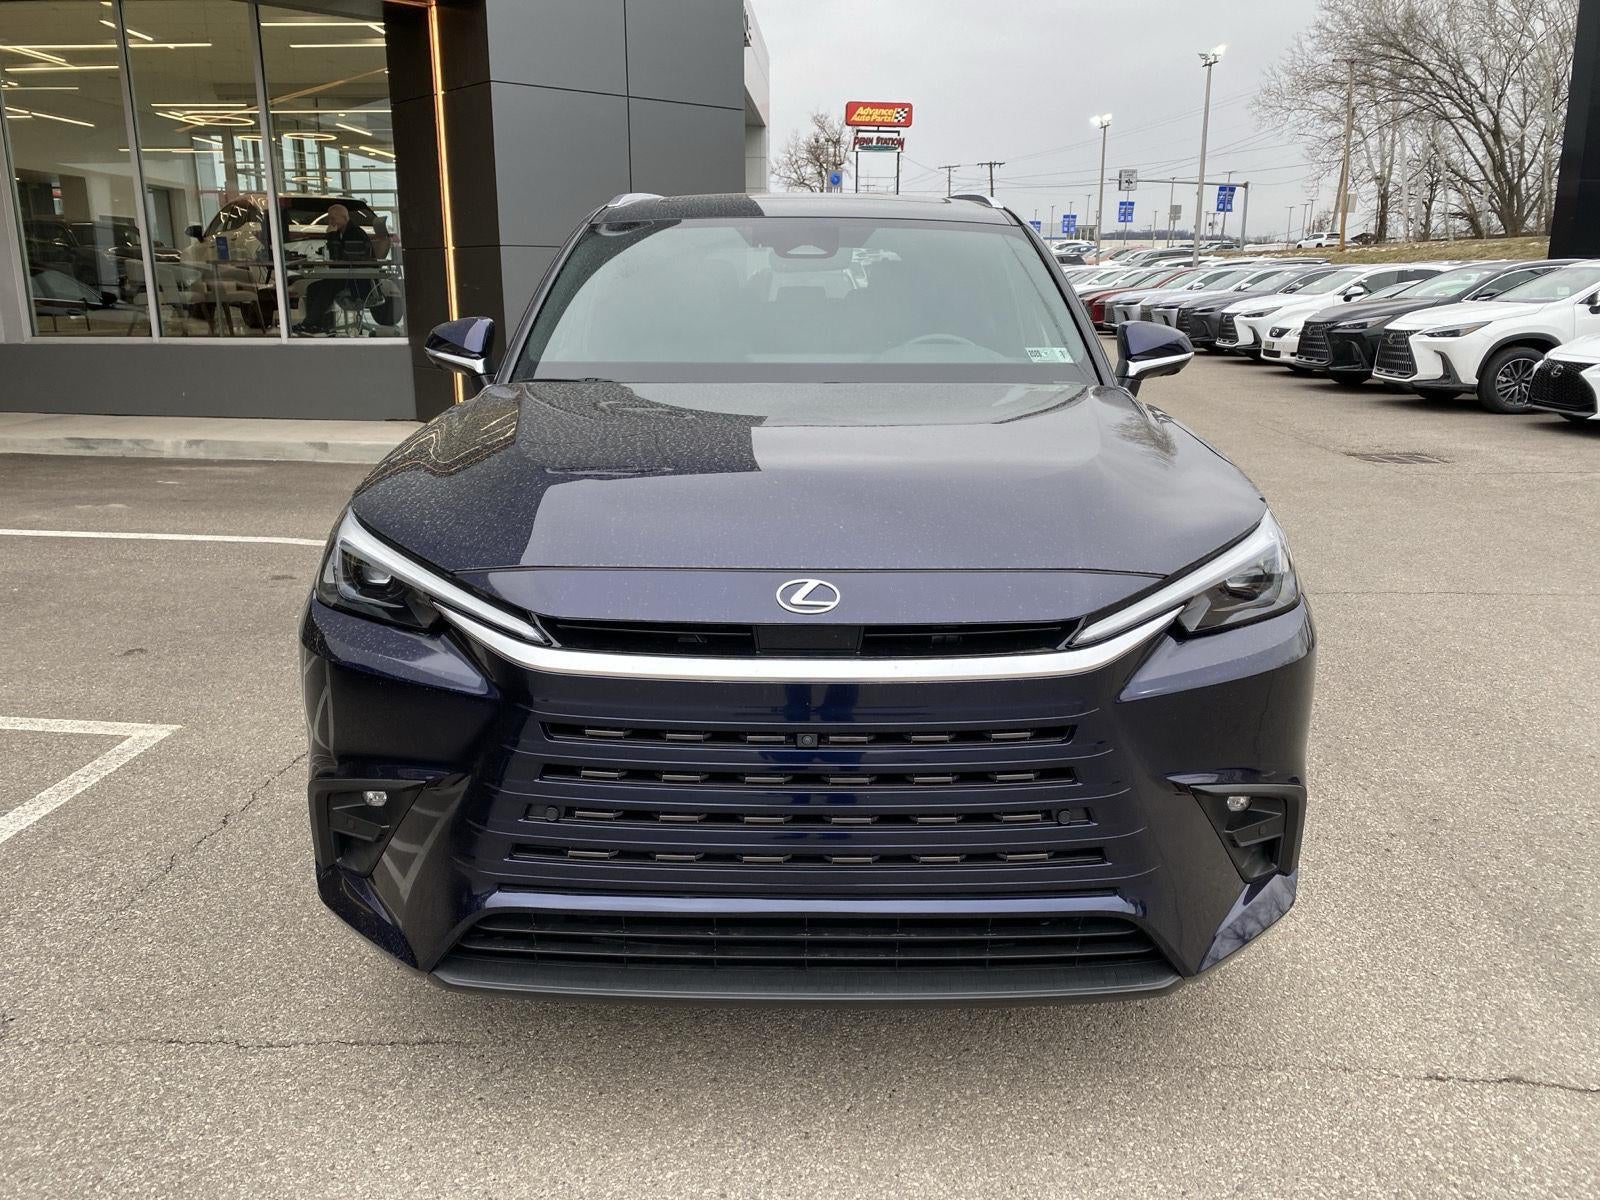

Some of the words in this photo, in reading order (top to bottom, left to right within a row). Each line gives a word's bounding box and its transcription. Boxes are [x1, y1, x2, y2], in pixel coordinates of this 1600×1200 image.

[855, 106, 894, 116] Advance
[850, 114, 871, 122] Auto
[871, 114, 893, 123] Parts
[876, 136, 905, 151] STATION
